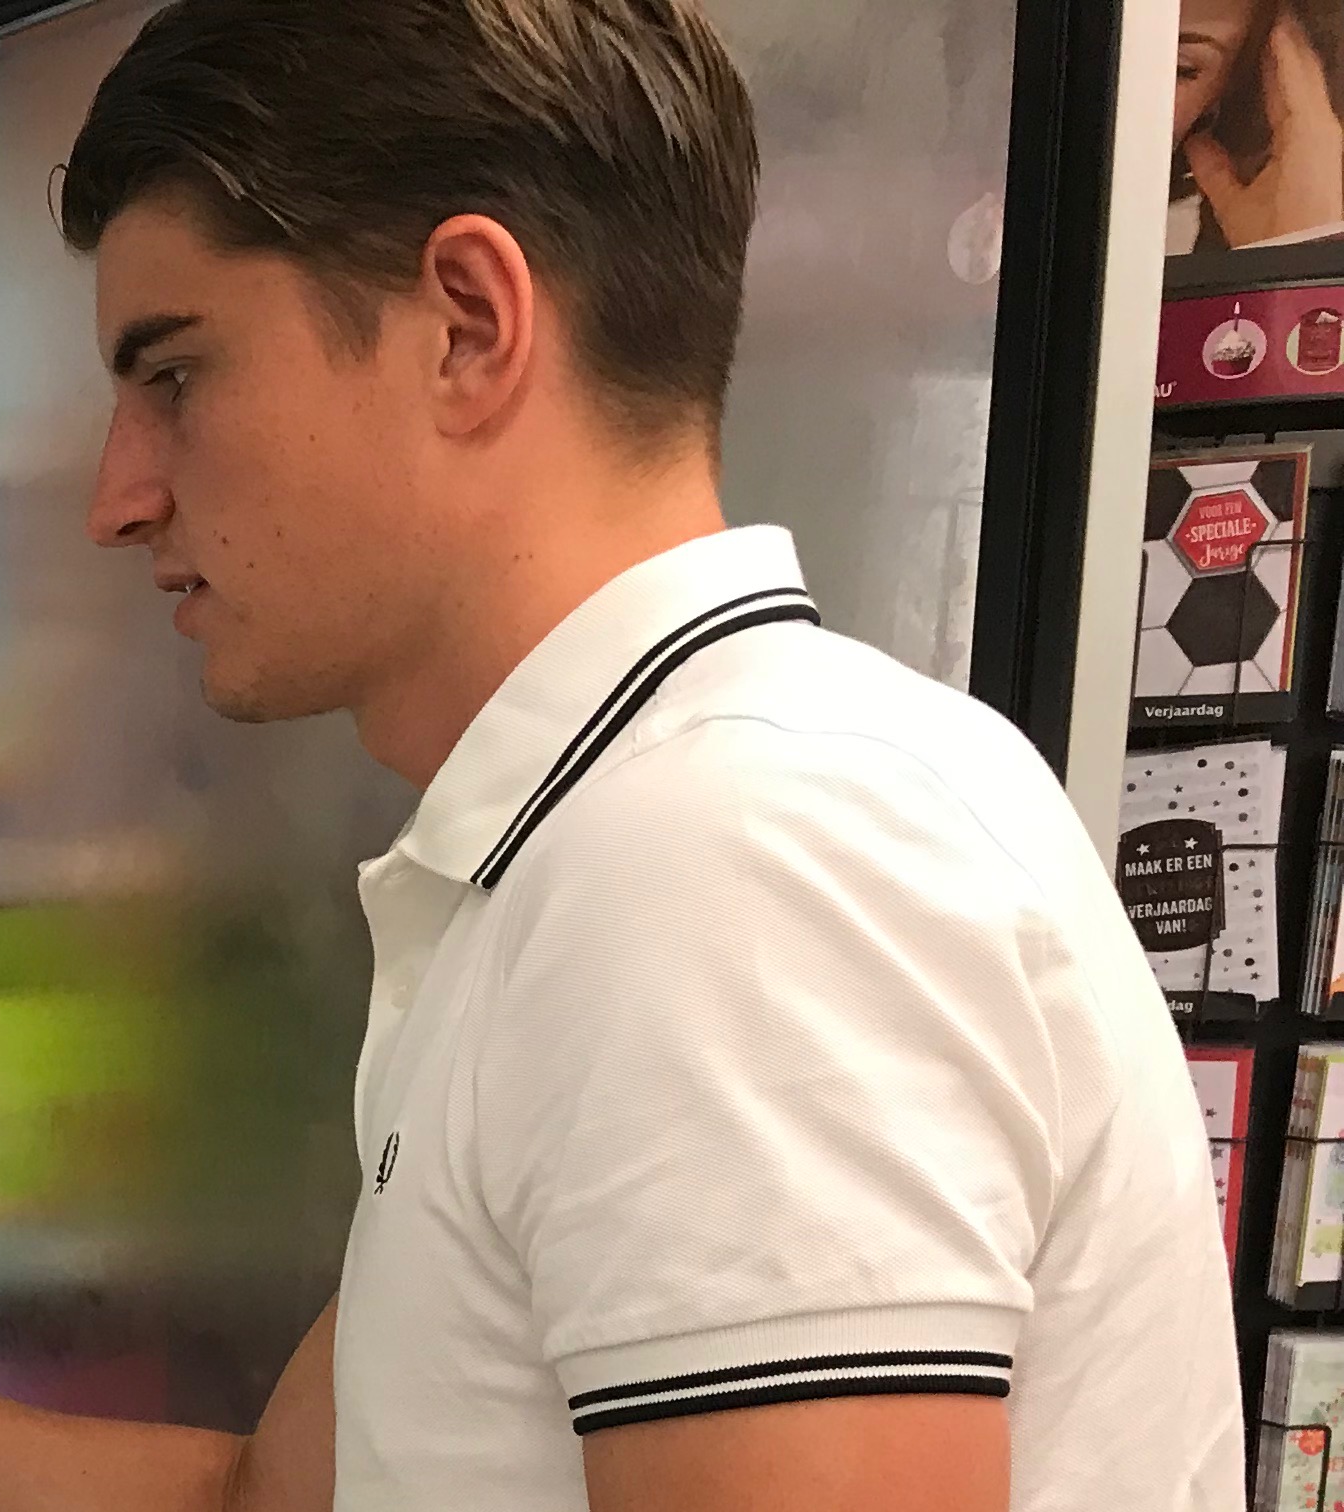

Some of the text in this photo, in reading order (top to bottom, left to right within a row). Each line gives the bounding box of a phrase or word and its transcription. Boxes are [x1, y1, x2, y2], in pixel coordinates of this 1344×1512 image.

[1190, 517, 1252, 543] SPECIALE
[1145, 704, 1224, 720] Verjaardag
[1125, 854, 1212, 877] MAAK ER EEN
[1128, 896, 1213, 919] VERJAARDAG
[1156, 918, 1187, 935] VAN!
